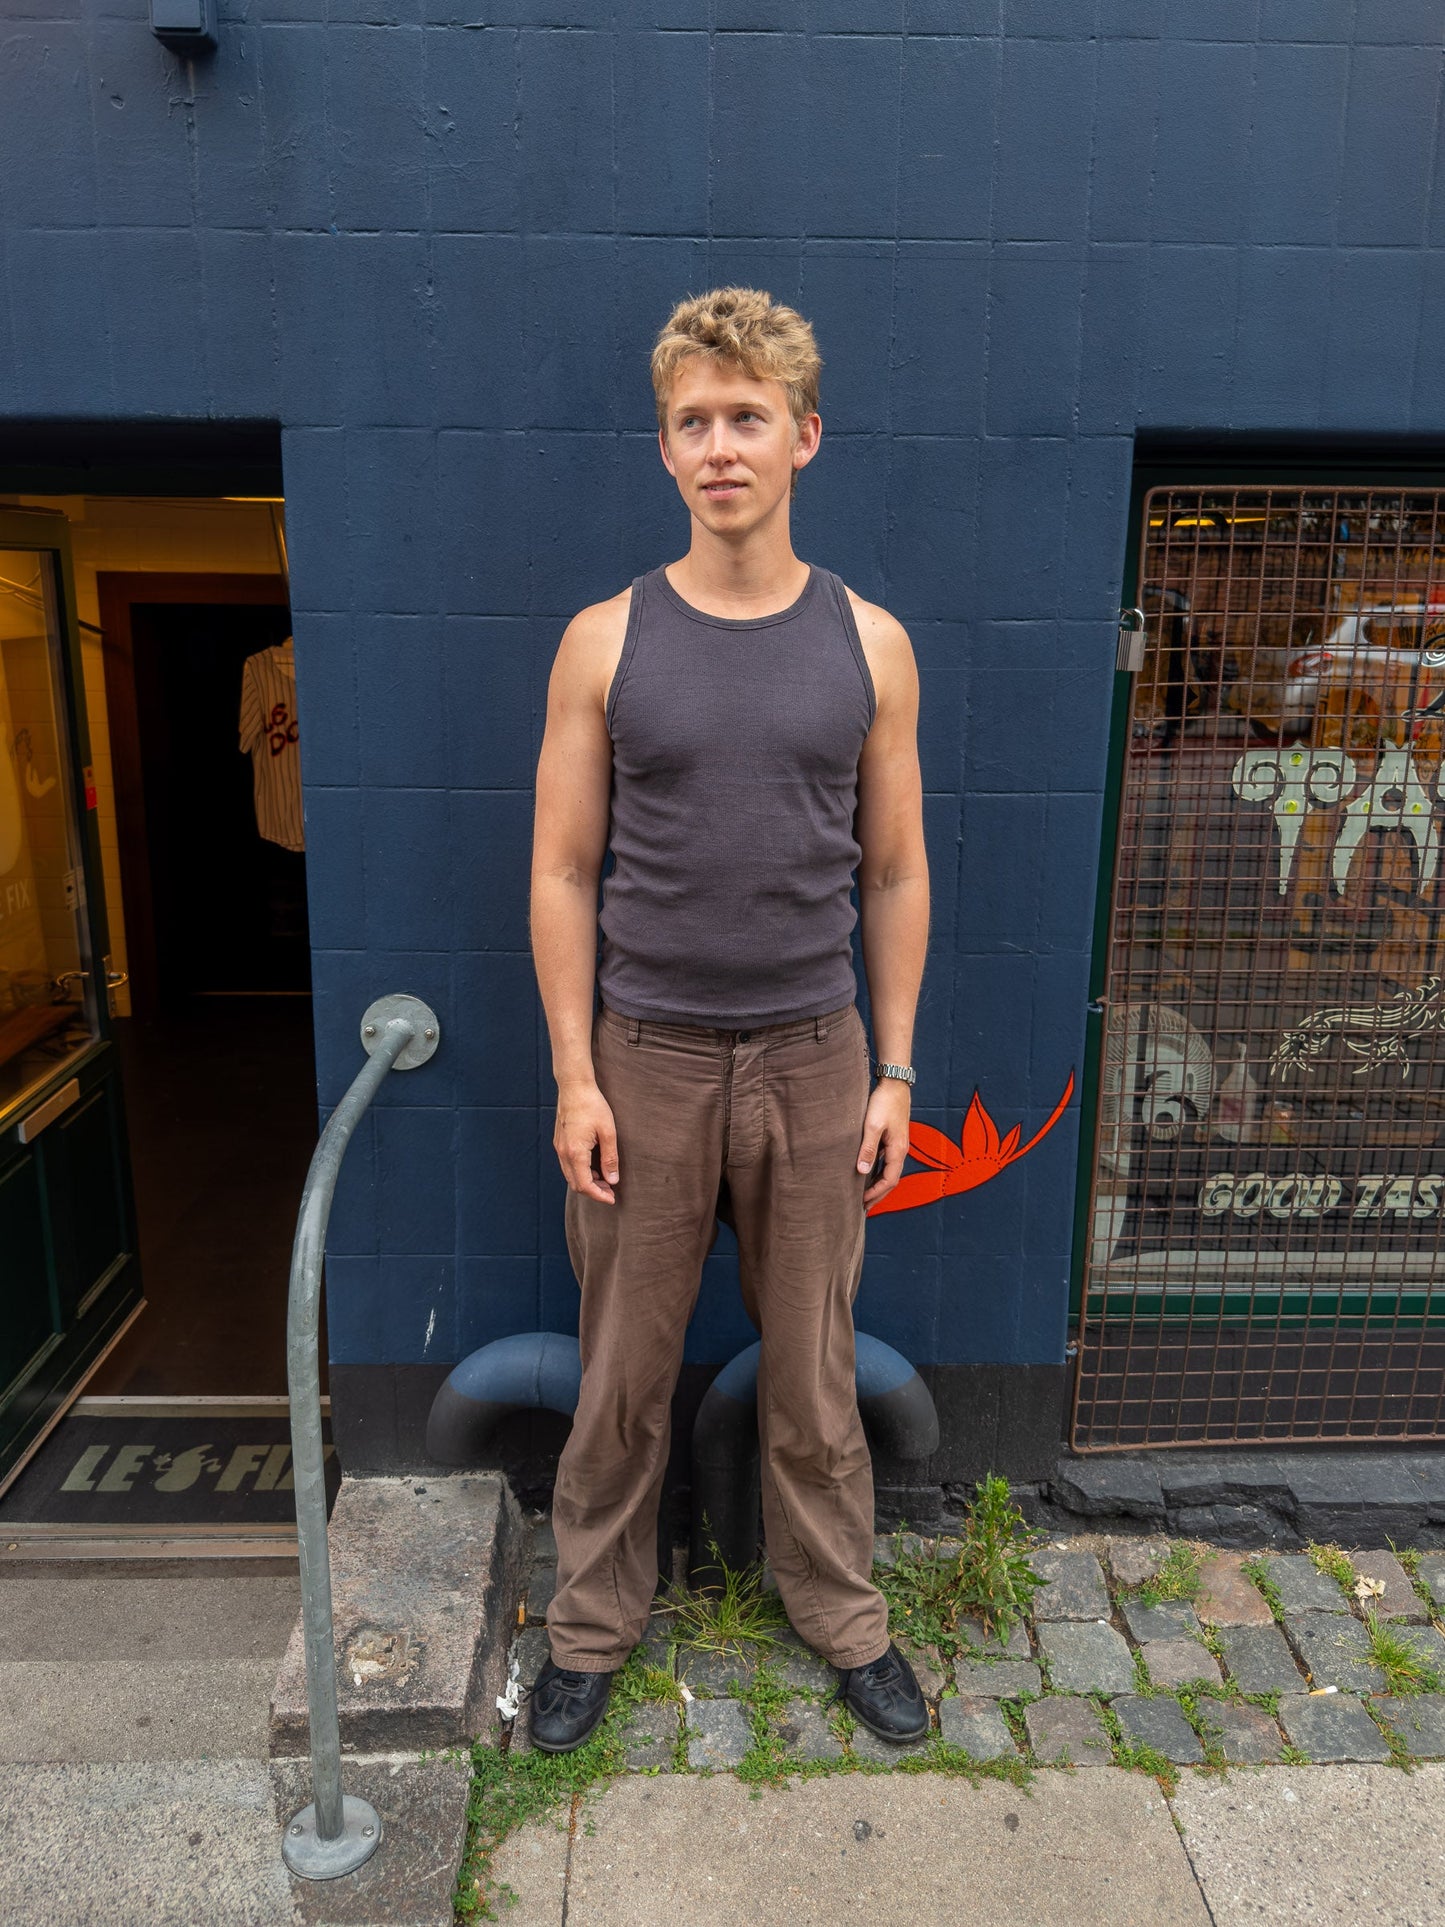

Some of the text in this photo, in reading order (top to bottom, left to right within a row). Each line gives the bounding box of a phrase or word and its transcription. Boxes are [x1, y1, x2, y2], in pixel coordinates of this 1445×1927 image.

[6, 879, 31, 916] FIX
[1198, 1172, 1445, 1217] GOOD TAS
[60, 1445, 155, 1491] LE
